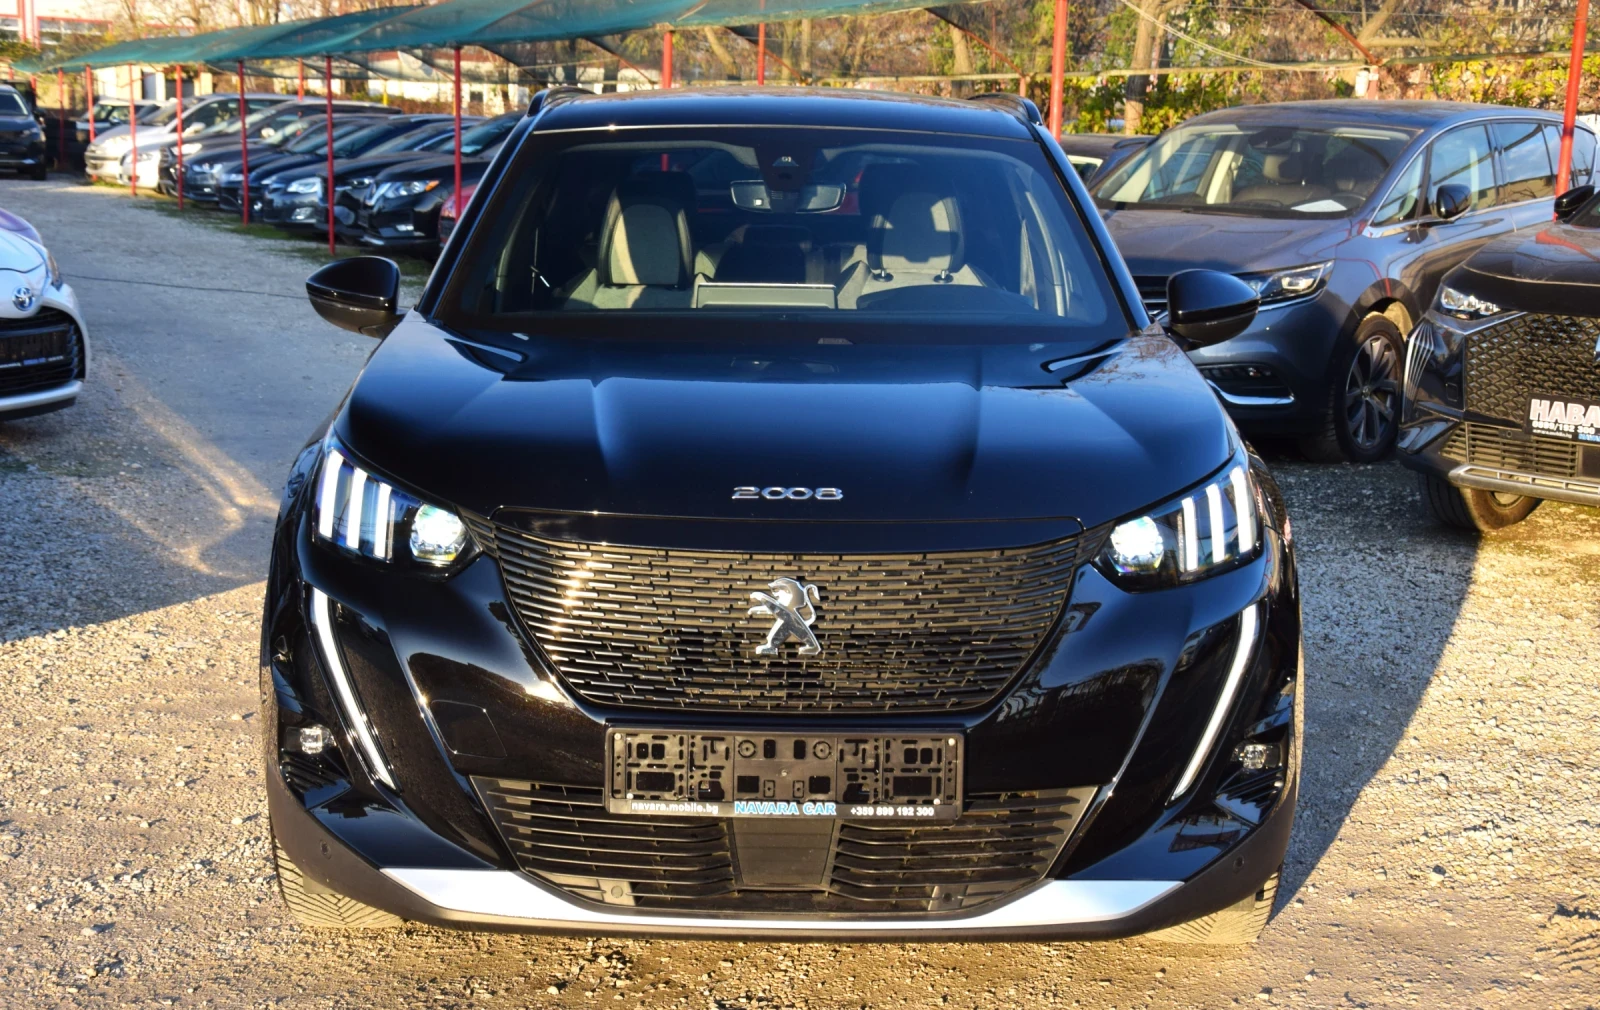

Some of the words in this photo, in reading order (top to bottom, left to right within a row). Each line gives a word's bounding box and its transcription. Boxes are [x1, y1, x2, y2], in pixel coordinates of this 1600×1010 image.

[731, 486, 844, 500] 2008
[631, 802, 719, 815] navara.mobile.bg
[734, 801, 800, 815] NAVARA
[802, 802, 837, 815] CAR
[850, 806, 874, 816] +359
[876, 806, 895, 816] 899
[896, 806, 915, 816] 192
[916, 806, 935, 816] 300
